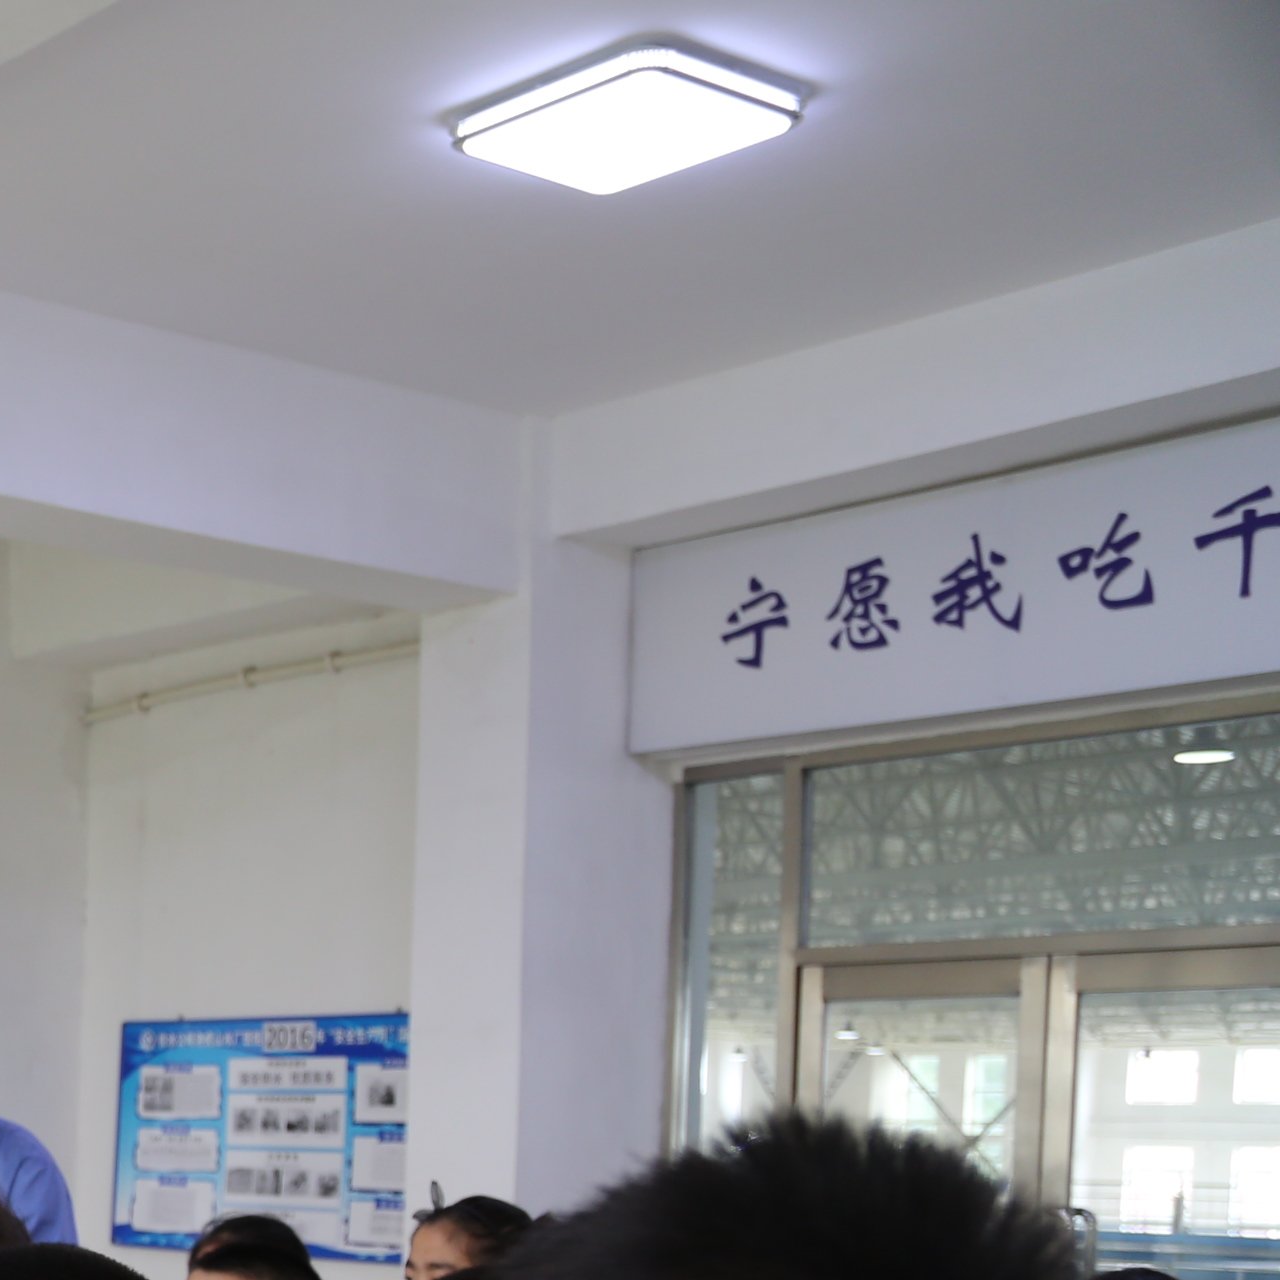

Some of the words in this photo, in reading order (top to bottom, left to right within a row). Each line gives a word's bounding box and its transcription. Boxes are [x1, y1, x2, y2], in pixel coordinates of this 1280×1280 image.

[720, 485, 1280, 669] 宁愿我吃千
